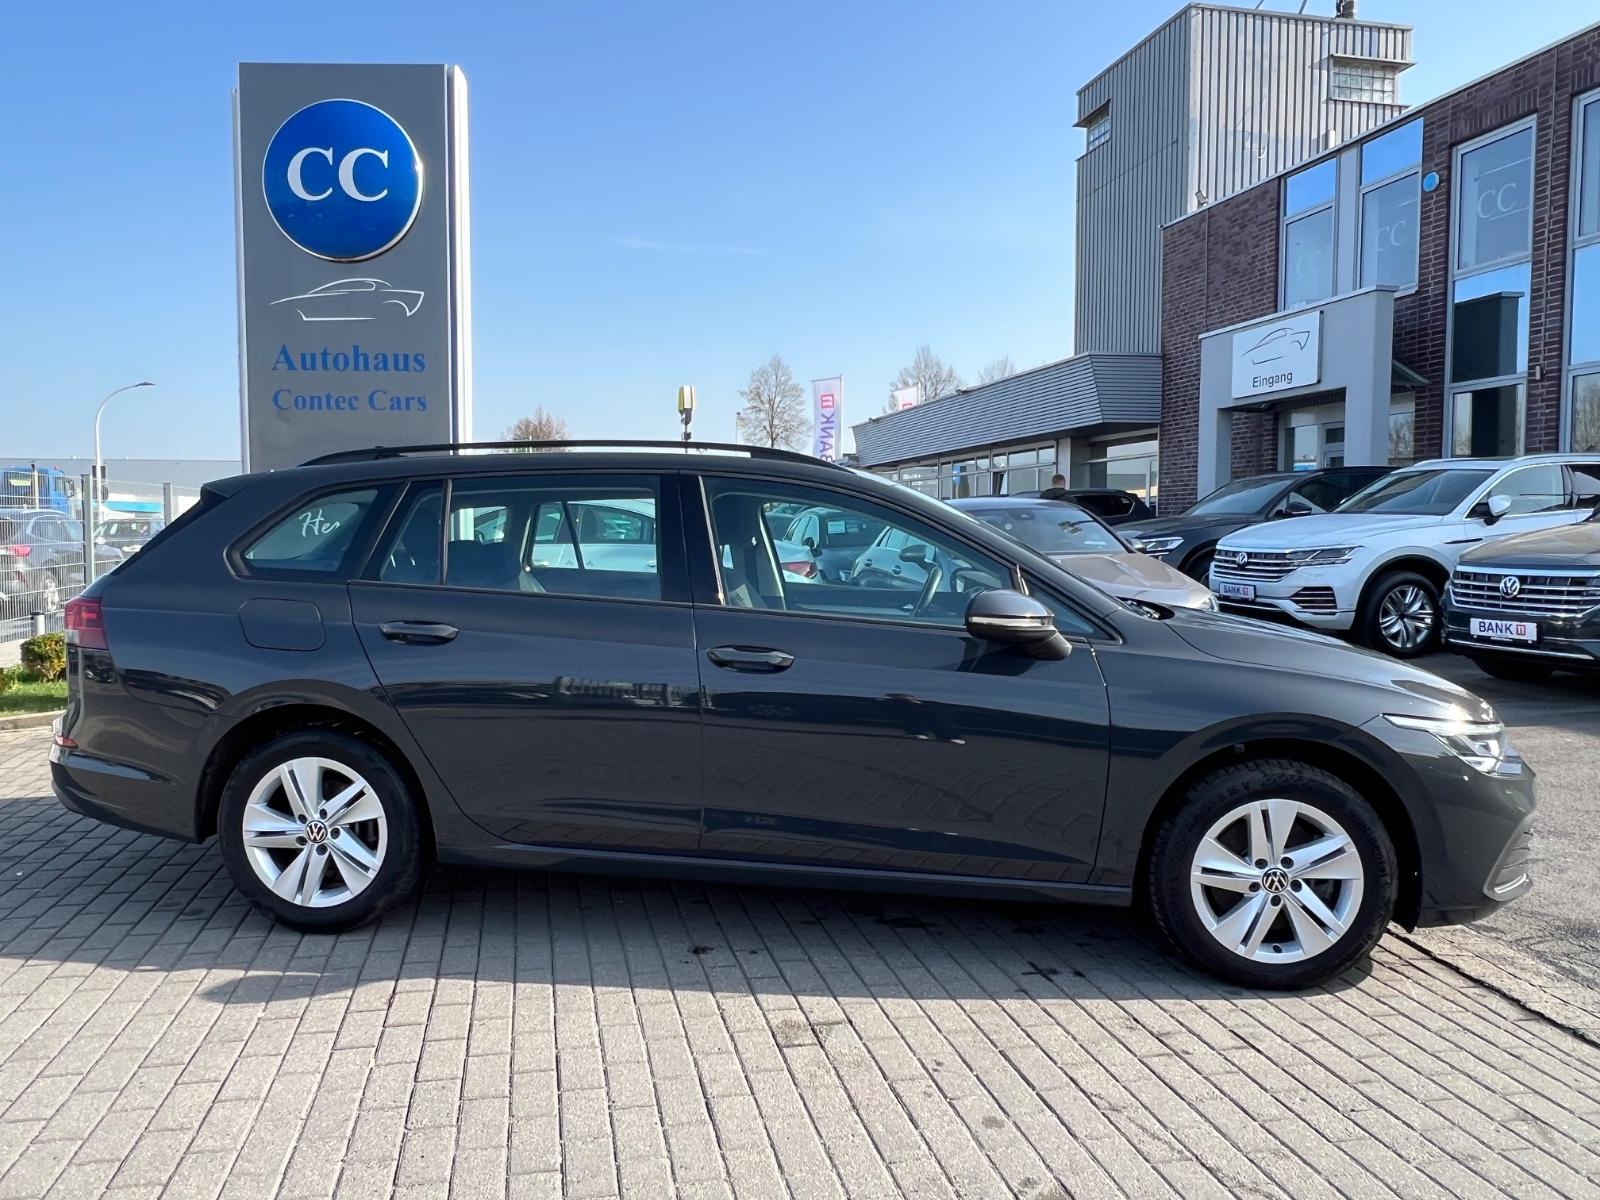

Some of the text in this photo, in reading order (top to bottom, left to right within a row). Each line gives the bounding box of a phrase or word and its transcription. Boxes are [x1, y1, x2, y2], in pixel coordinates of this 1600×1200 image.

[287, 146, 390, 203] CC
[271, 344, 427, 372] Autohaus
[1252, 372, 1293, 388] Eingang
[271, 389, 428, 412] Contec Cars
[1223, 584, 1242, 595] BANK
[1478, 620, 1513, 635] BANK
